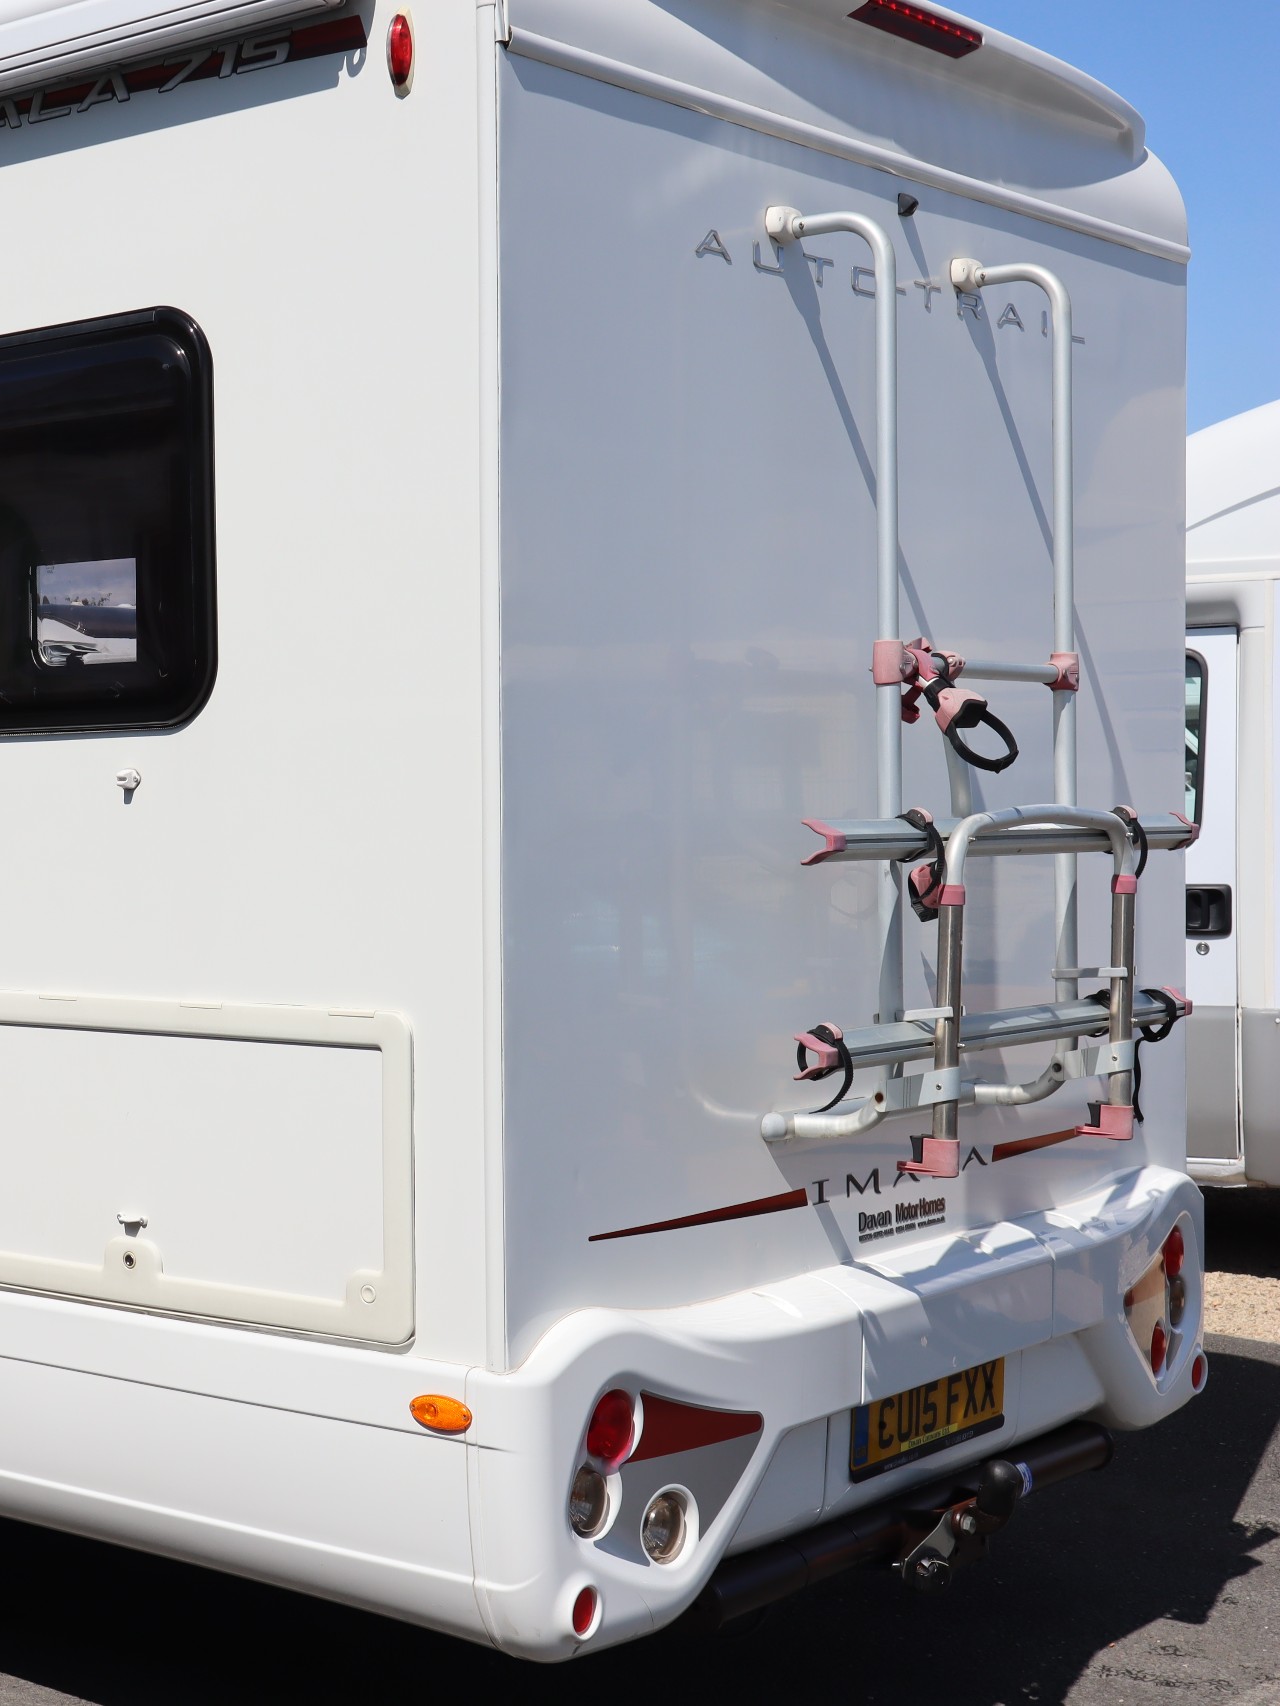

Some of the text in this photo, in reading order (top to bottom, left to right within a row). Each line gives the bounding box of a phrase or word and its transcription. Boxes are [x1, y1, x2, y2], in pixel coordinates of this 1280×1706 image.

[158, 27, 294, 94] 715
[694, 228, 1086, 345] AUTO-TRAI
[811, 1146, 988, 1206] IMAA
[858, 1210, 893, 1234] Davan
[946, 1360, 998, 1426] FXX
